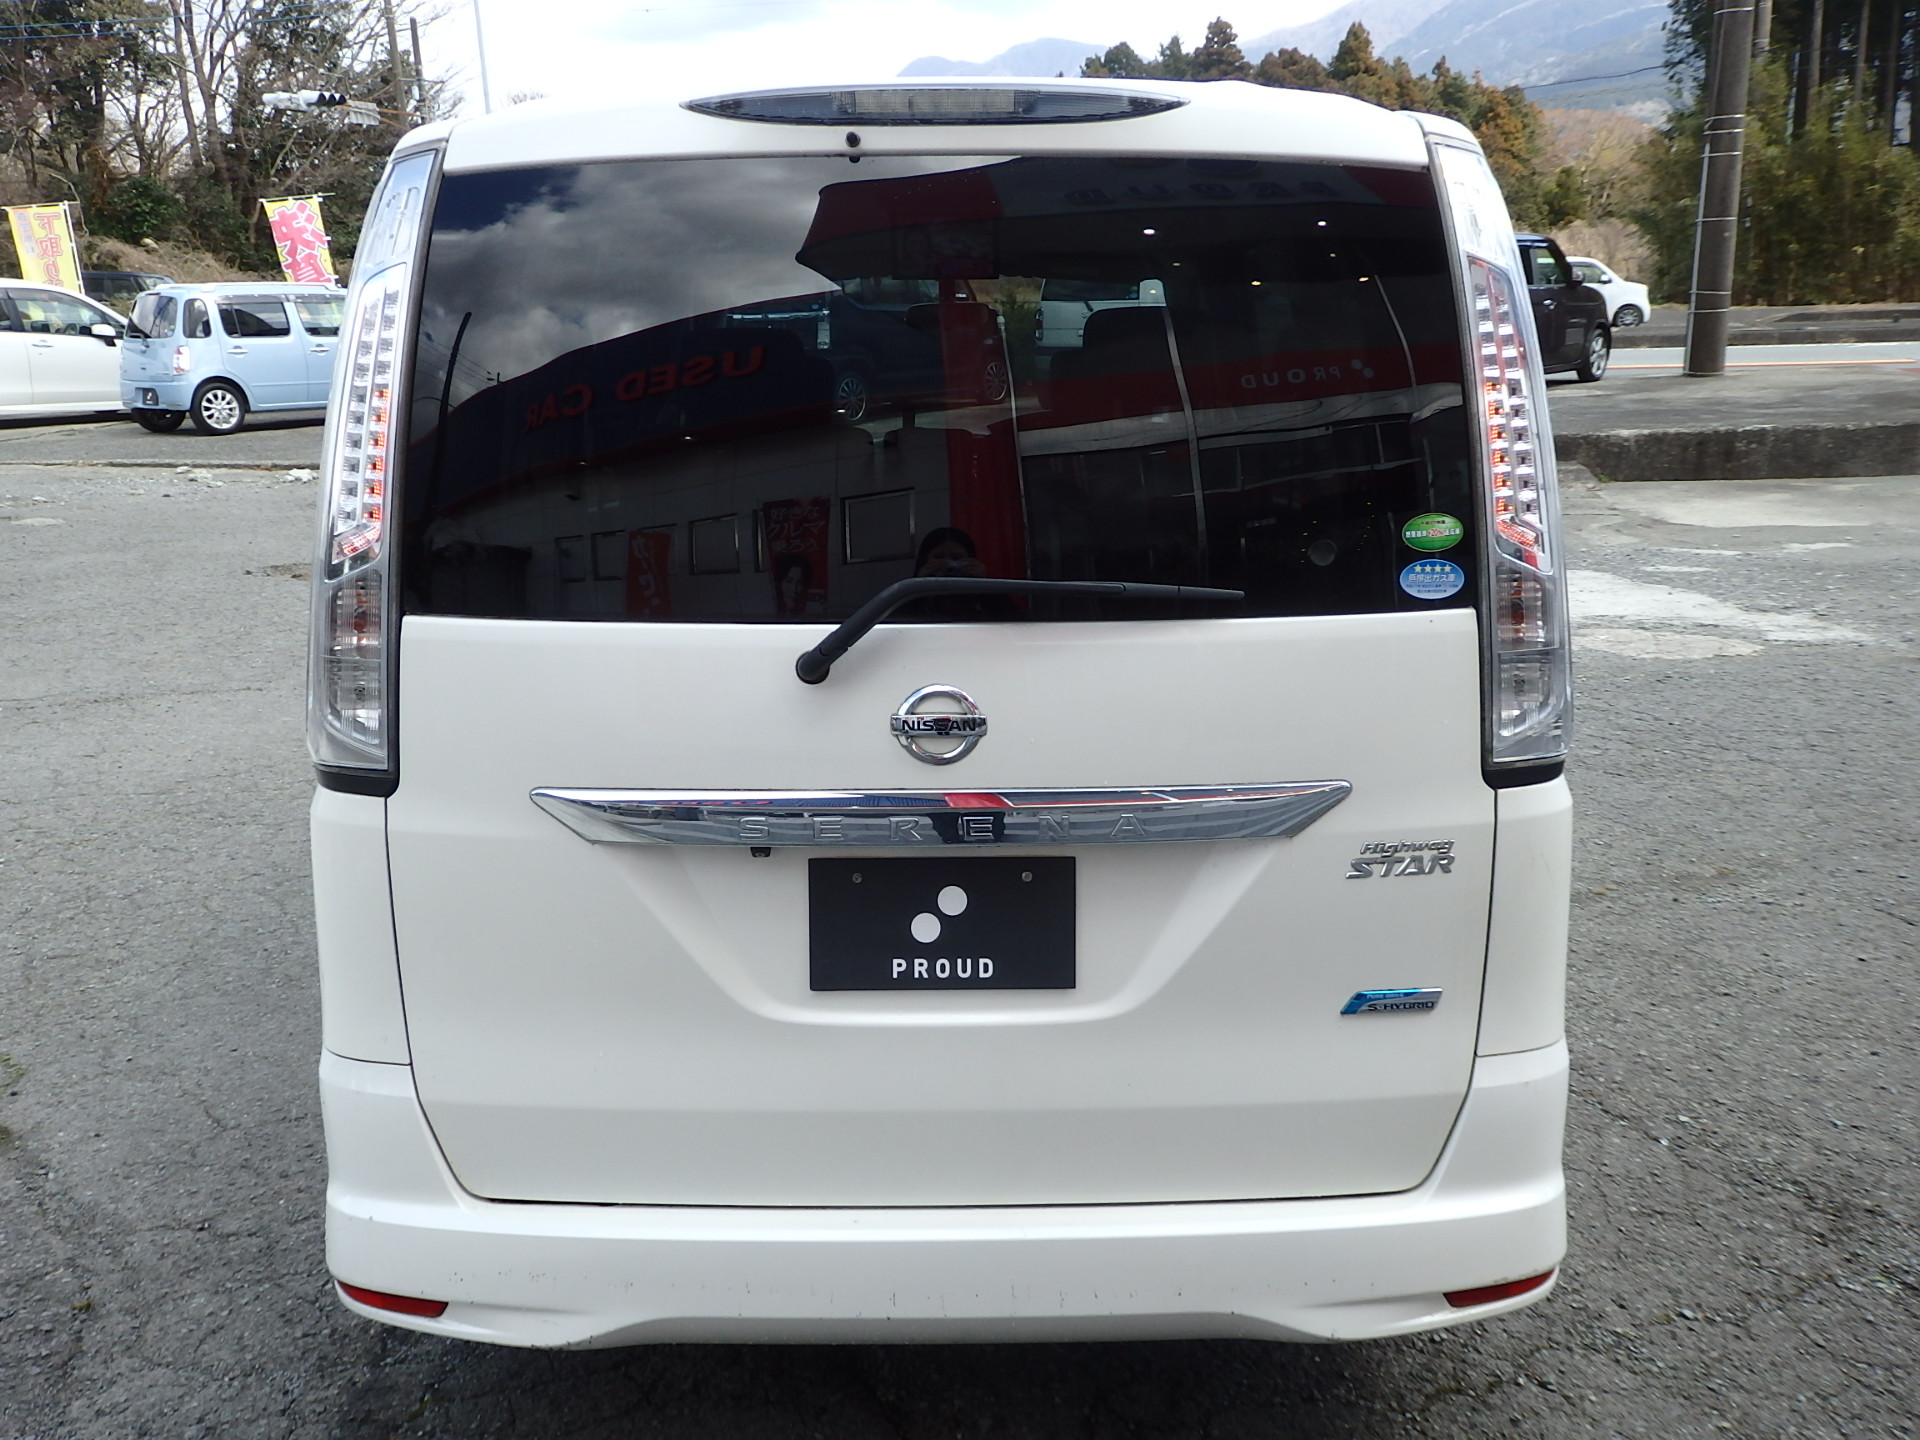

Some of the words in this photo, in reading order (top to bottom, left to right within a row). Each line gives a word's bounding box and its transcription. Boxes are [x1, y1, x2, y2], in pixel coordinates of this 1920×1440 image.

[901, 718, 977, 732] NISSAN
[738, 813, 1147, 842] SERENA
[1360, 839, 1455, 858] Highway
[1345, 853, 1456, 879] STAR
[892, 957, 995, 980] PROUD
